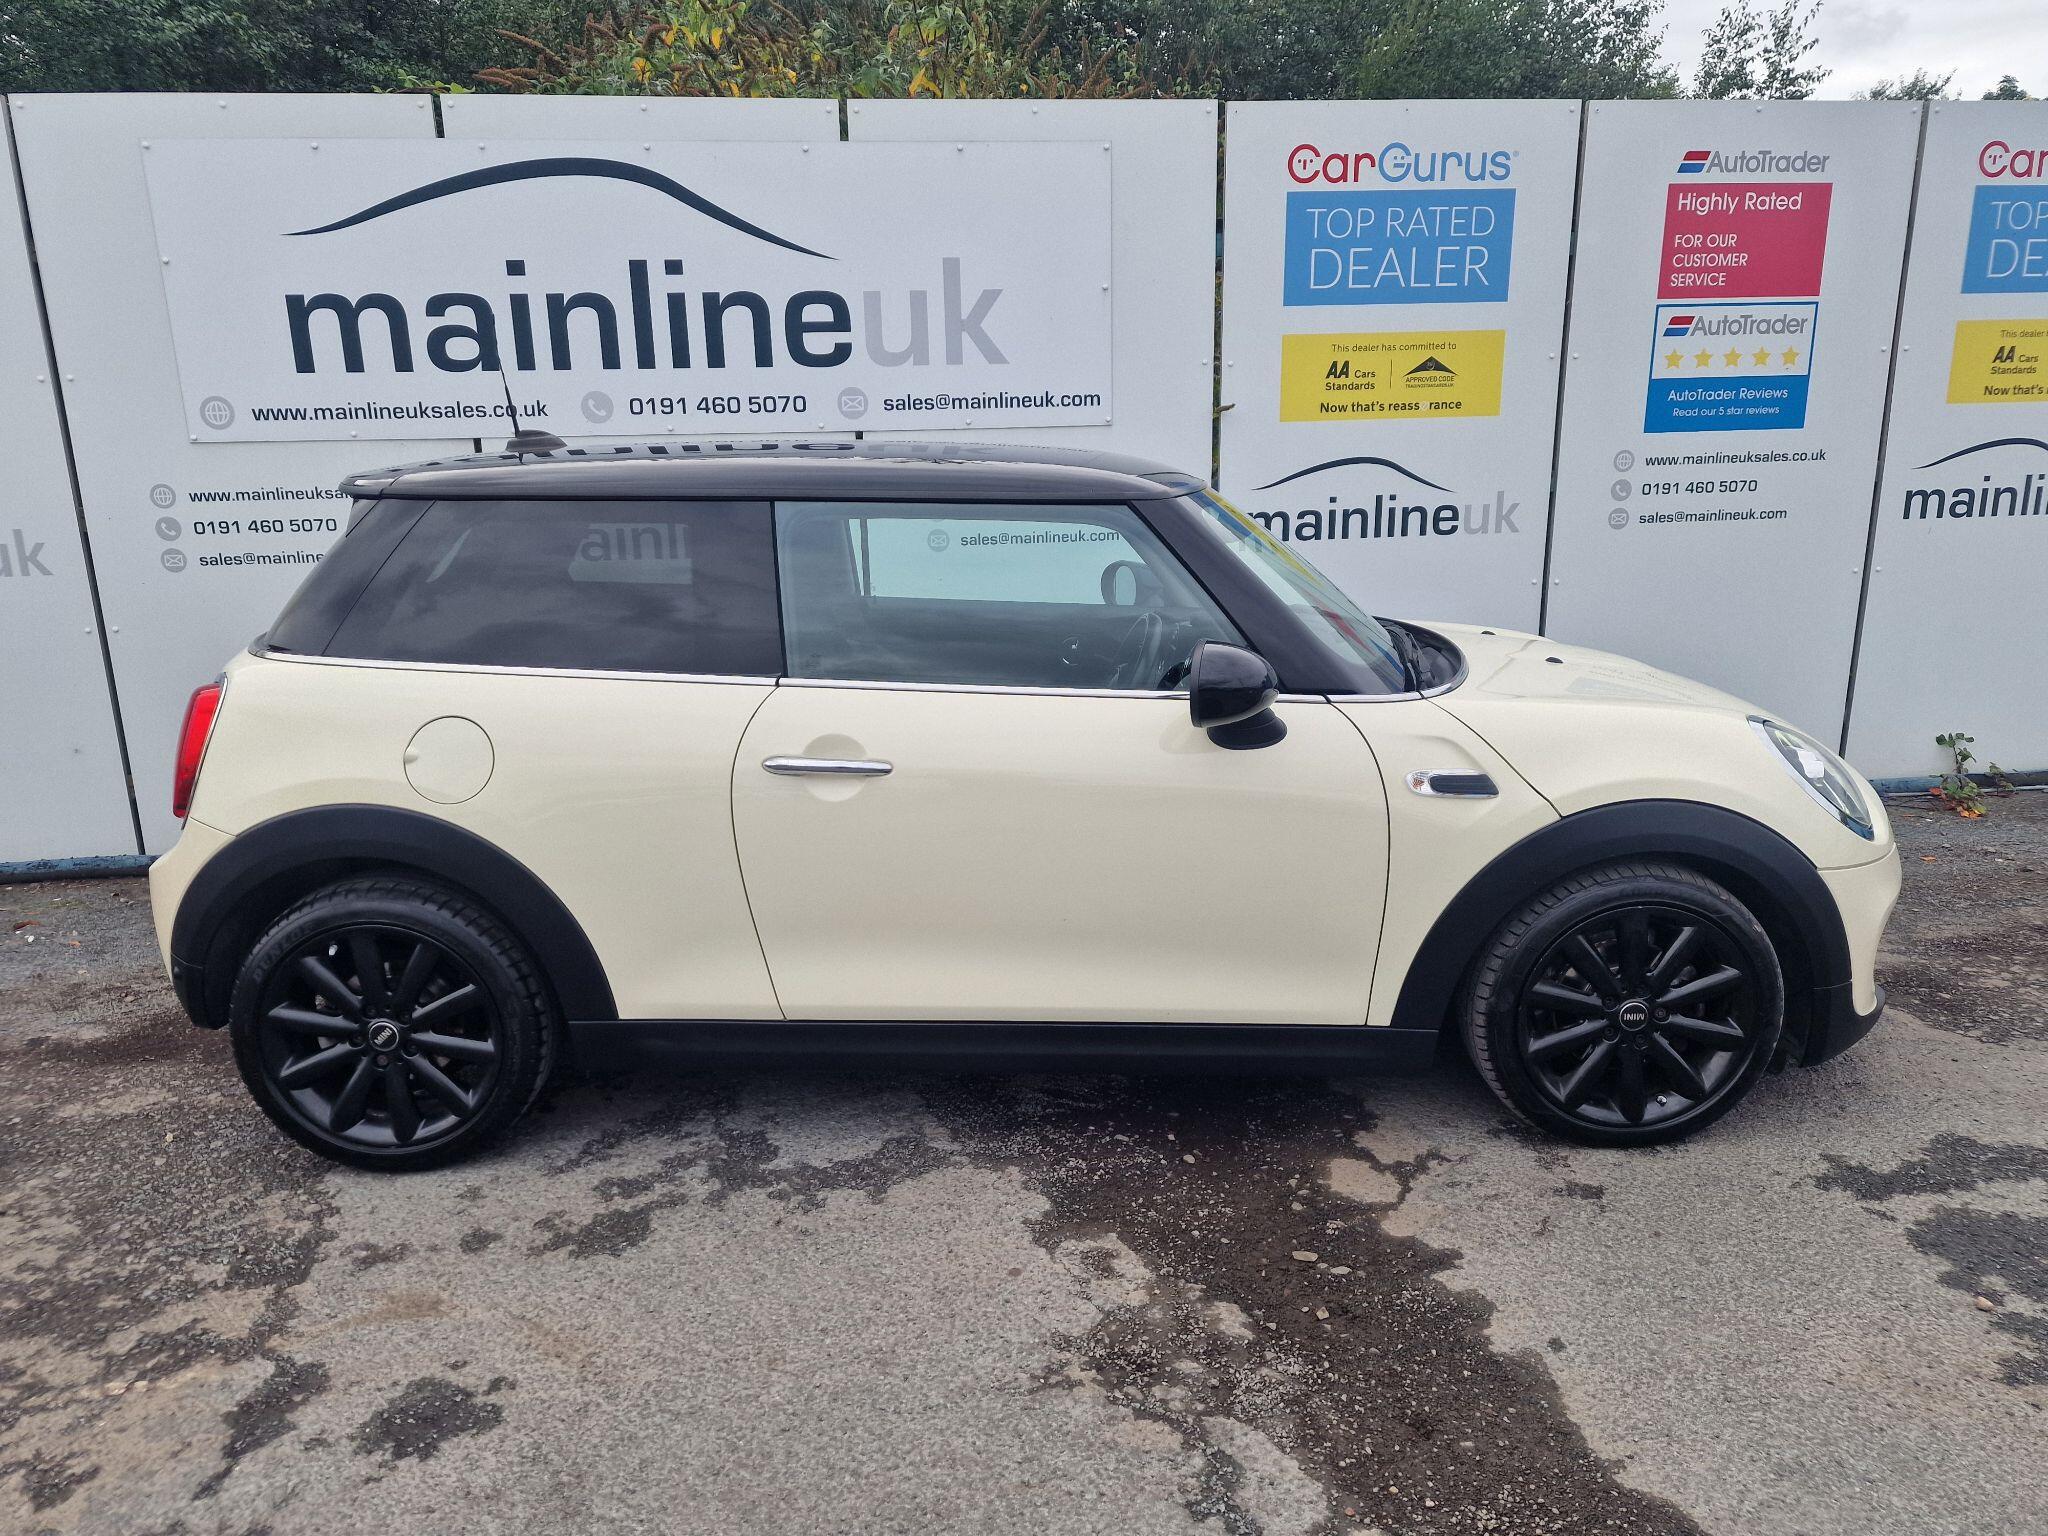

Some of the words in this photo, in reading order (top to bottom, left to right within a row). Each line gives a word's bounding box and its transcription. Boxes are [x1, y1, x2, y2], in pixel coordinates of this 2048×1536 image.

[1287, 142, 1511, 184] CarGurus
[1706, 150, 1830, 173] AutoTrader
[1678, 192, 1740, 216] Highly
[1744, 191, 1803, 211] Rated
[1306, 207, 1375, 239] TOP
[1386, 206, 1495, 238] RATED
[1674, 234, 1703, 248] FOR
[1706, 233, 1738, 248] OUR
[1310, 245, 1490, 289] DEALER
[1672, 253, 1749, 268] CUSTOMER
[1987, 238, 2048, 278] DE
[1670, 272, 1727, 287] SERVICE
[284, 256, 1011, 374] mainlineuk
[1690, 314, 1809, 337] AutoTrader
[2000, 329, 2018, 338] This
[2019, 329, 2045, 338] dealer
[1332, 343, 1350, 353] This
[1352, 343, 1380, 352] dealer
[1381, 342, 1397, 352] has
[1399, 342, 1446, 351] committed
[1448, 341, 1457, 351] to
[1991, 345, 2017, 363] AA
[2019, 354, 2040, 363] Cars
[1325, 360, 1350, 379] AA
[1354, 369, 1376, 379] Cars
[1990, 365, 2038, 375] Standards
[1325, 381, 1376, 391] Standards
[1405, 375, 1438, 383] APPROVED
[1667, 388, 1736, 401] AutoTrader
[1739, 387, 1789, 399] Reviews
[1983, 385, 2011, 396] Now
[2012, 384, 2045, 395] that's
[629, 397, 687, 415] 0191
[696, 396, 741, 414] 460
[748, 395, 807, 413] 5070
[883, 390, 1101, 411] sales@mainlineuk.com
[1320, 402, 1348, 414] Now
[1351, 401, 1385, 413] that's
[1388, 401, 1463, 412] reassrance
[251, 399, 550, 421] www.mainlineuksales.co.uk
[1672, 407, 1699, 417] Read
[1701, 408, 1717, 417] our
[1718, 407, 1725, 416] 5
[1726, 406, 1744, 416] star
[1745, 406, 1780, 416] reviews
[1645, 449, 1827, 467] www.mainlineuksales.co.uk
[1641, 482, 1681, 496] 0191
[1685, 480, 1715, 494] 460
[1718, 479, 1758, 493] 5070
[1902, 473, 2048, 520] mainli
[1638, 508, 1788, 525] sales@mainlineuk.com
[193, 520, 241, 535] 0191
[247, 519, 284, 534] 460
[289, 518, 338, 532] 5070
[960, 529, 1120, 547] sales@mainlineuk.com
[1623, 1012, 1645, 1021] MINI
[373, 1026, 393, 1046] MINI
